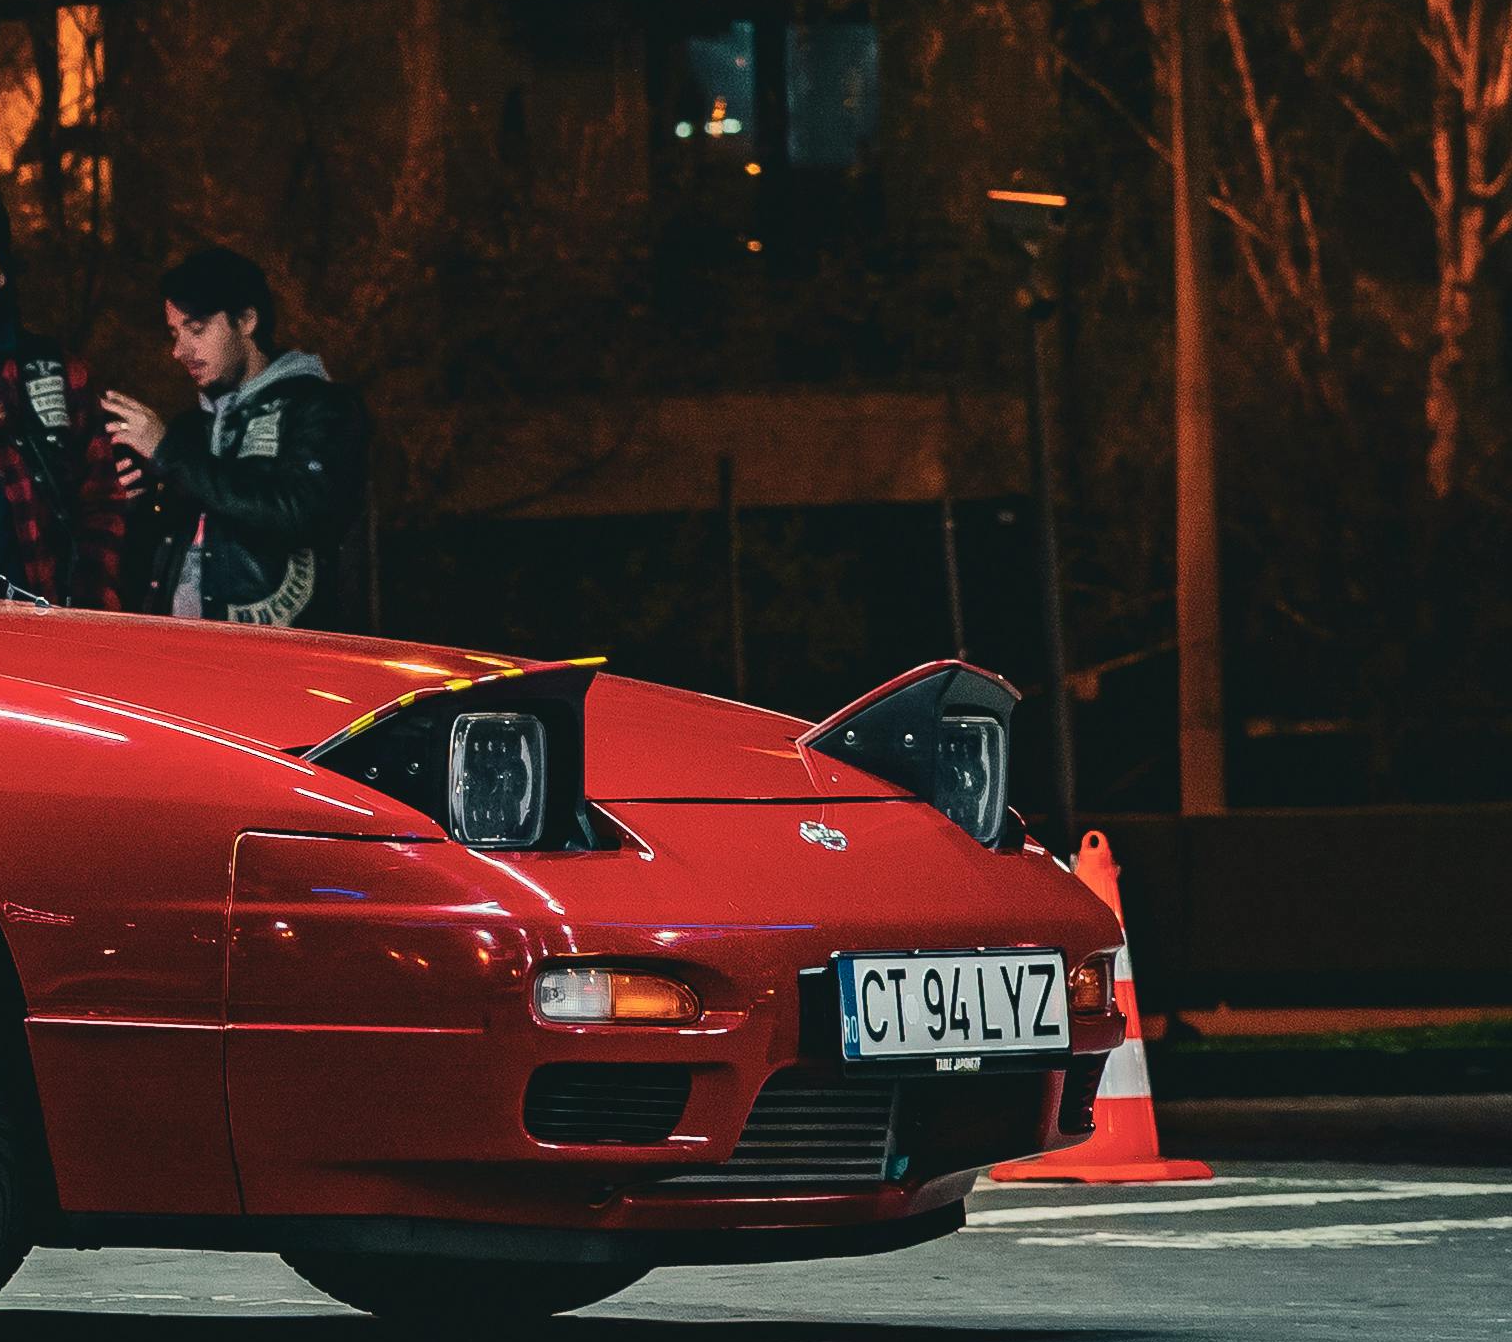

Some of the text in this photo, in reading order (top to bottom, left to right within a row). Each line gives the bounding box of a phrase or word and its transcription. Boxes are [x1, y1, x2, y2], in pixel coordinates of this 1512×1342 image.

[844, 1015, 859, 1044] RO
[861, 963, 1061, 1043] CT 94 LYZ
